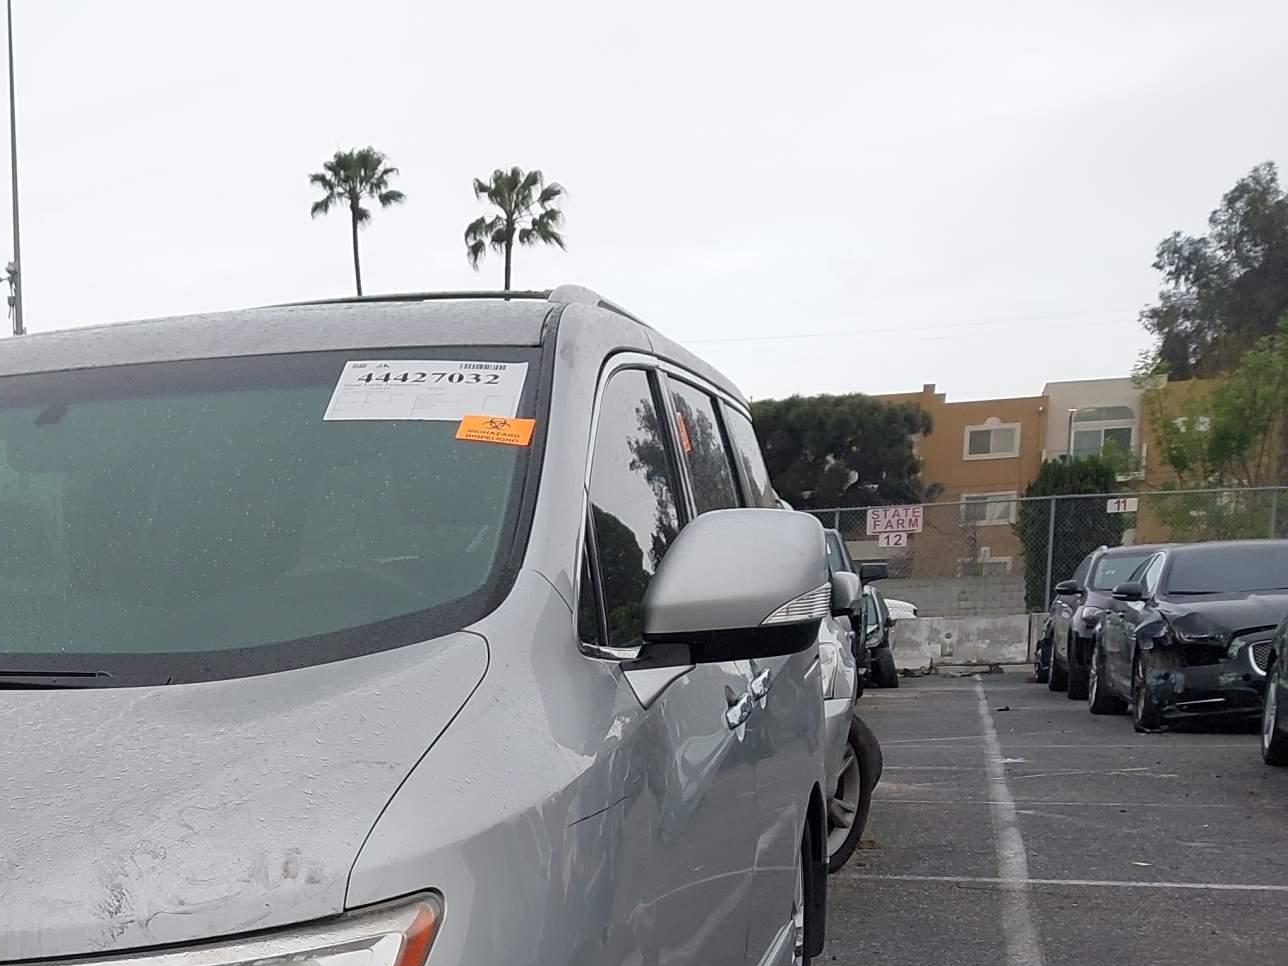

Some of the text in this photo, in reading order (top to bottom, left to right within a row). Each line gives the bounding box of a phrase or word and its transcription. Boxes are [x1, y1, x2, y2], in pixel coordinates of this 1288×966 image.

[357, 371, 501, 385] 44427032
[1114, 499, 1127, 511] 11
[871, 507, 921, 520] STATE
[873, 518, 919, 530] FARM
[884, 534, 902, 546] 12
